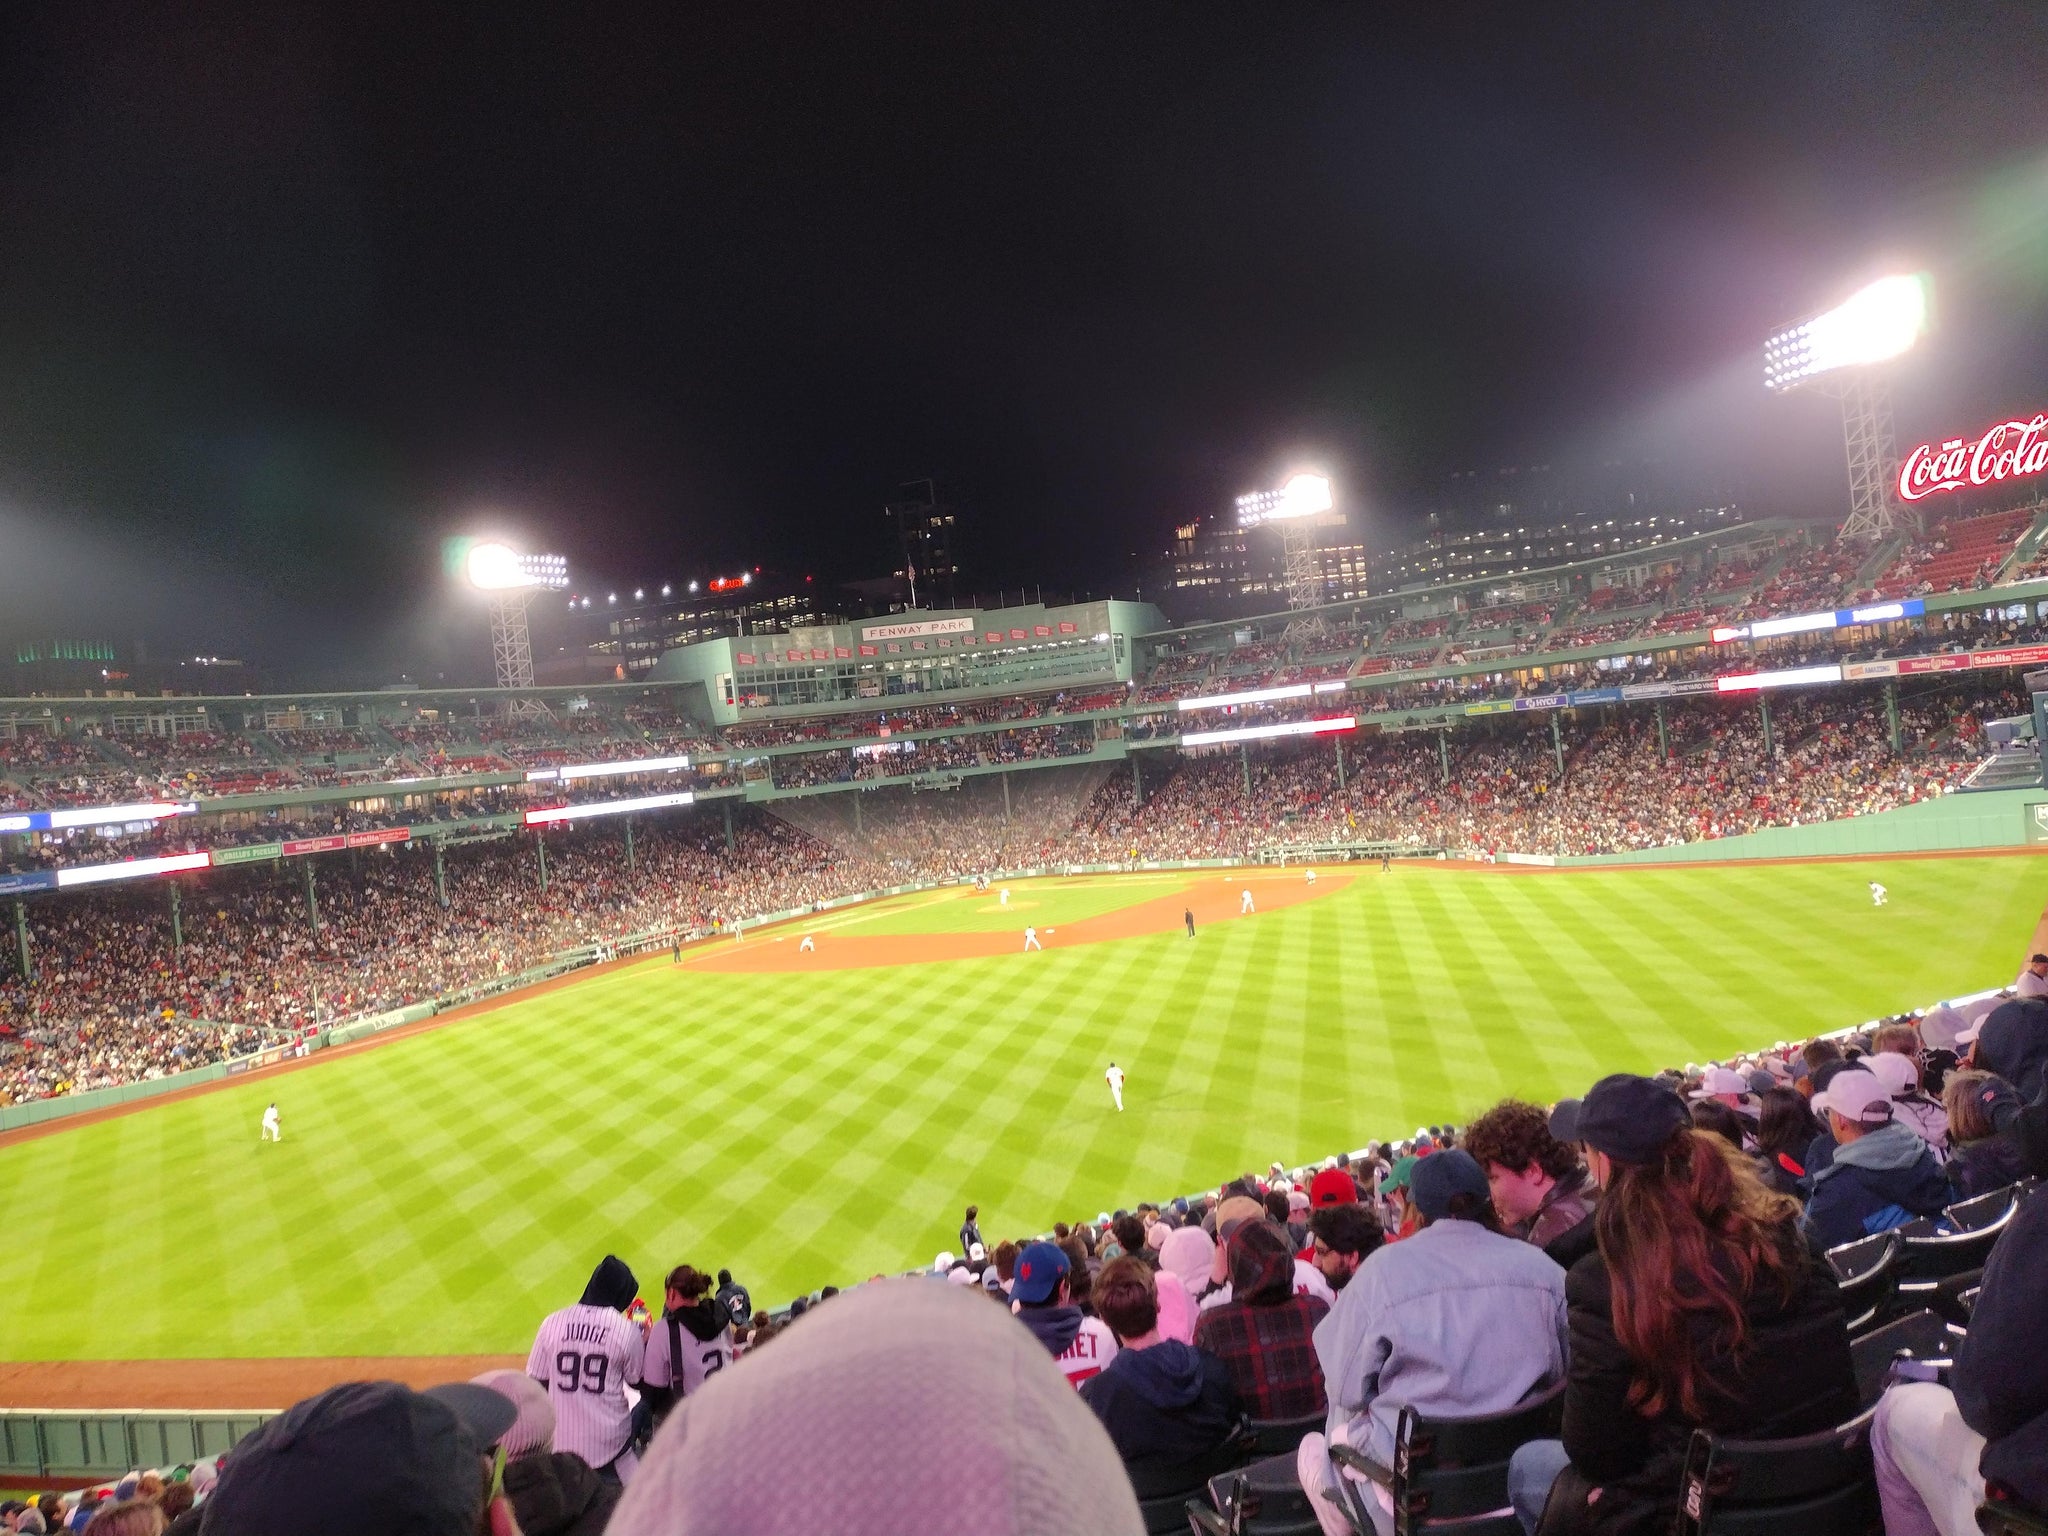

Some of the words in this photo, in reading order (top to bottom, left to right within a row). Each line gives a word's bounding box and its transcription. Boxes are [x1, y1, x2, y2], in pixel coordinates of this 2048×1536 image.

[1900, 415, 2048, 500] Coca-Cola
[870, 625, 922, 638] FENWAY
[931, 621, 967, 632] PARK
[1974, 653, 2012, 665] Safelite
[1536, 697, 1557, 707] HYCU
[562, 1321, 610, 1345] JUDGE
[556, 1351, 609, 1394] 99
